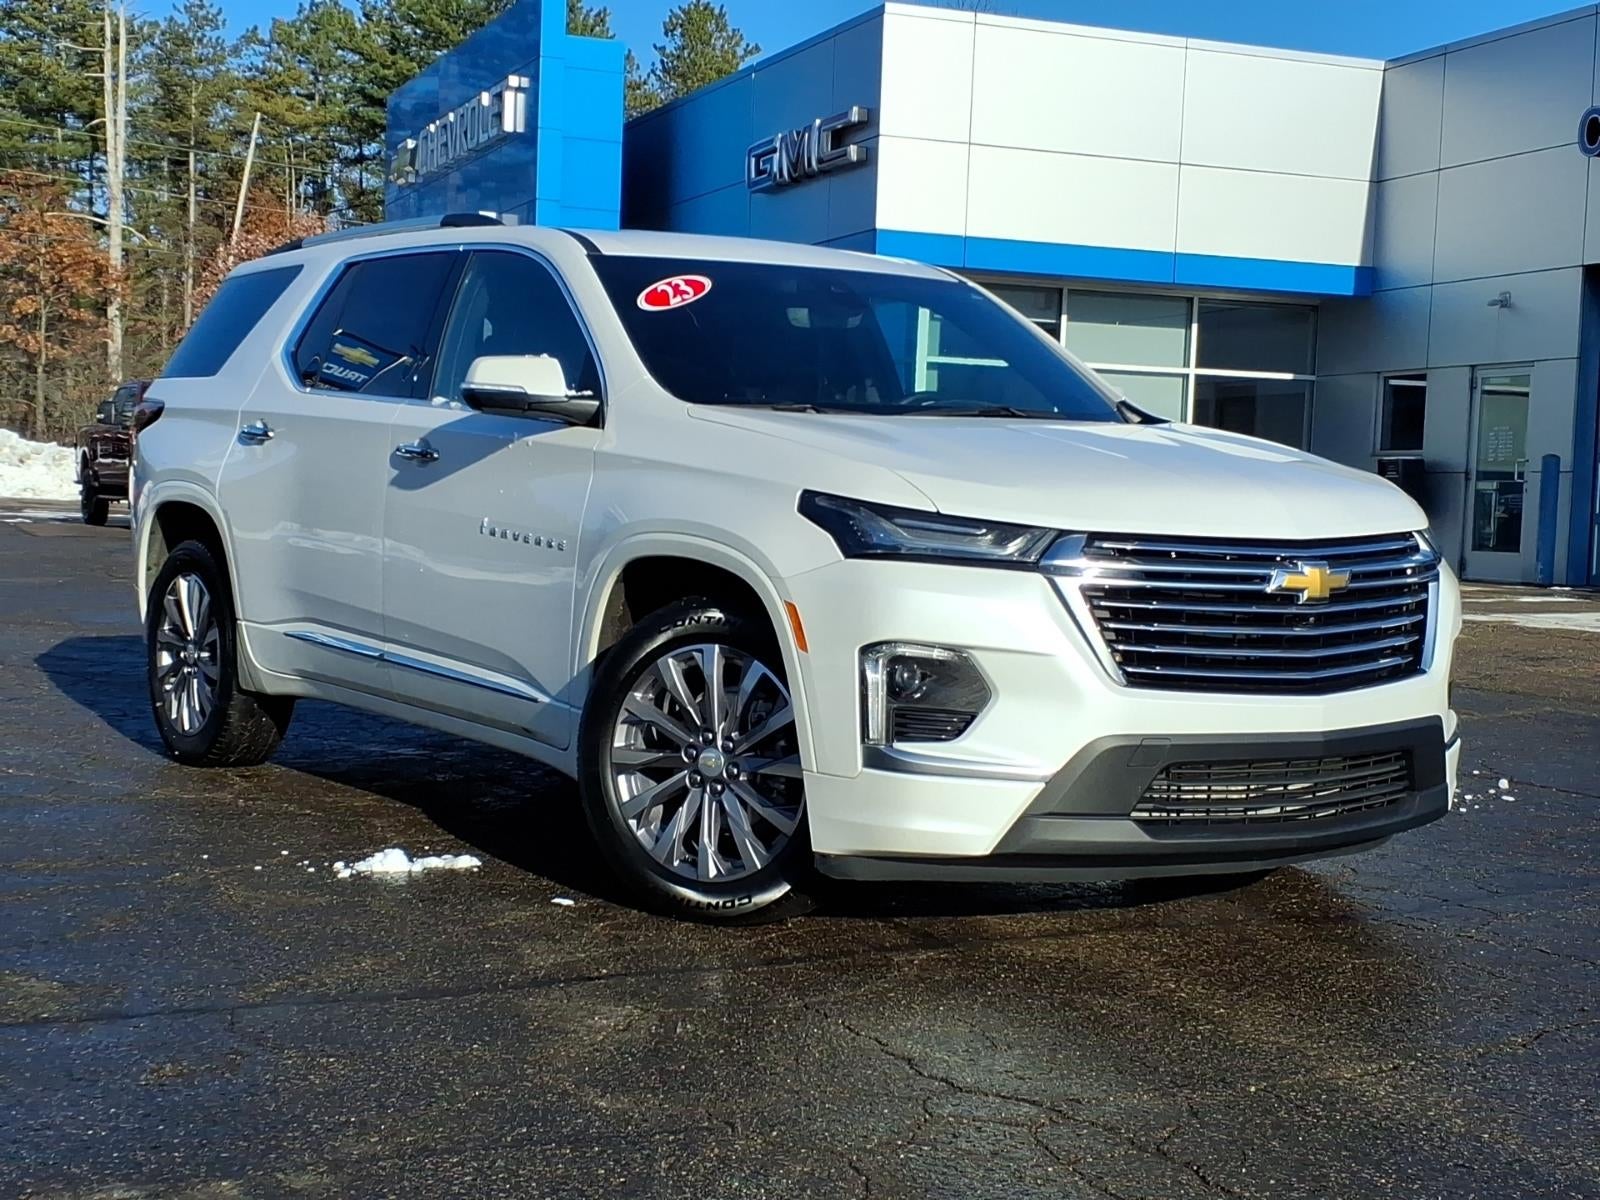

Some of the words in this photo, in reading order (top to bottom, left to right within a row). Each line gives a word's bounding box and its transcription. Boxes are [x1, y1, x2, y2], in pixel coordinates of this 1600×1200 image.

[416, 74, 530, 176] CHEVROLET
[745, 105, 868, 191] GMC
[656, 279, 695, 305] 23
